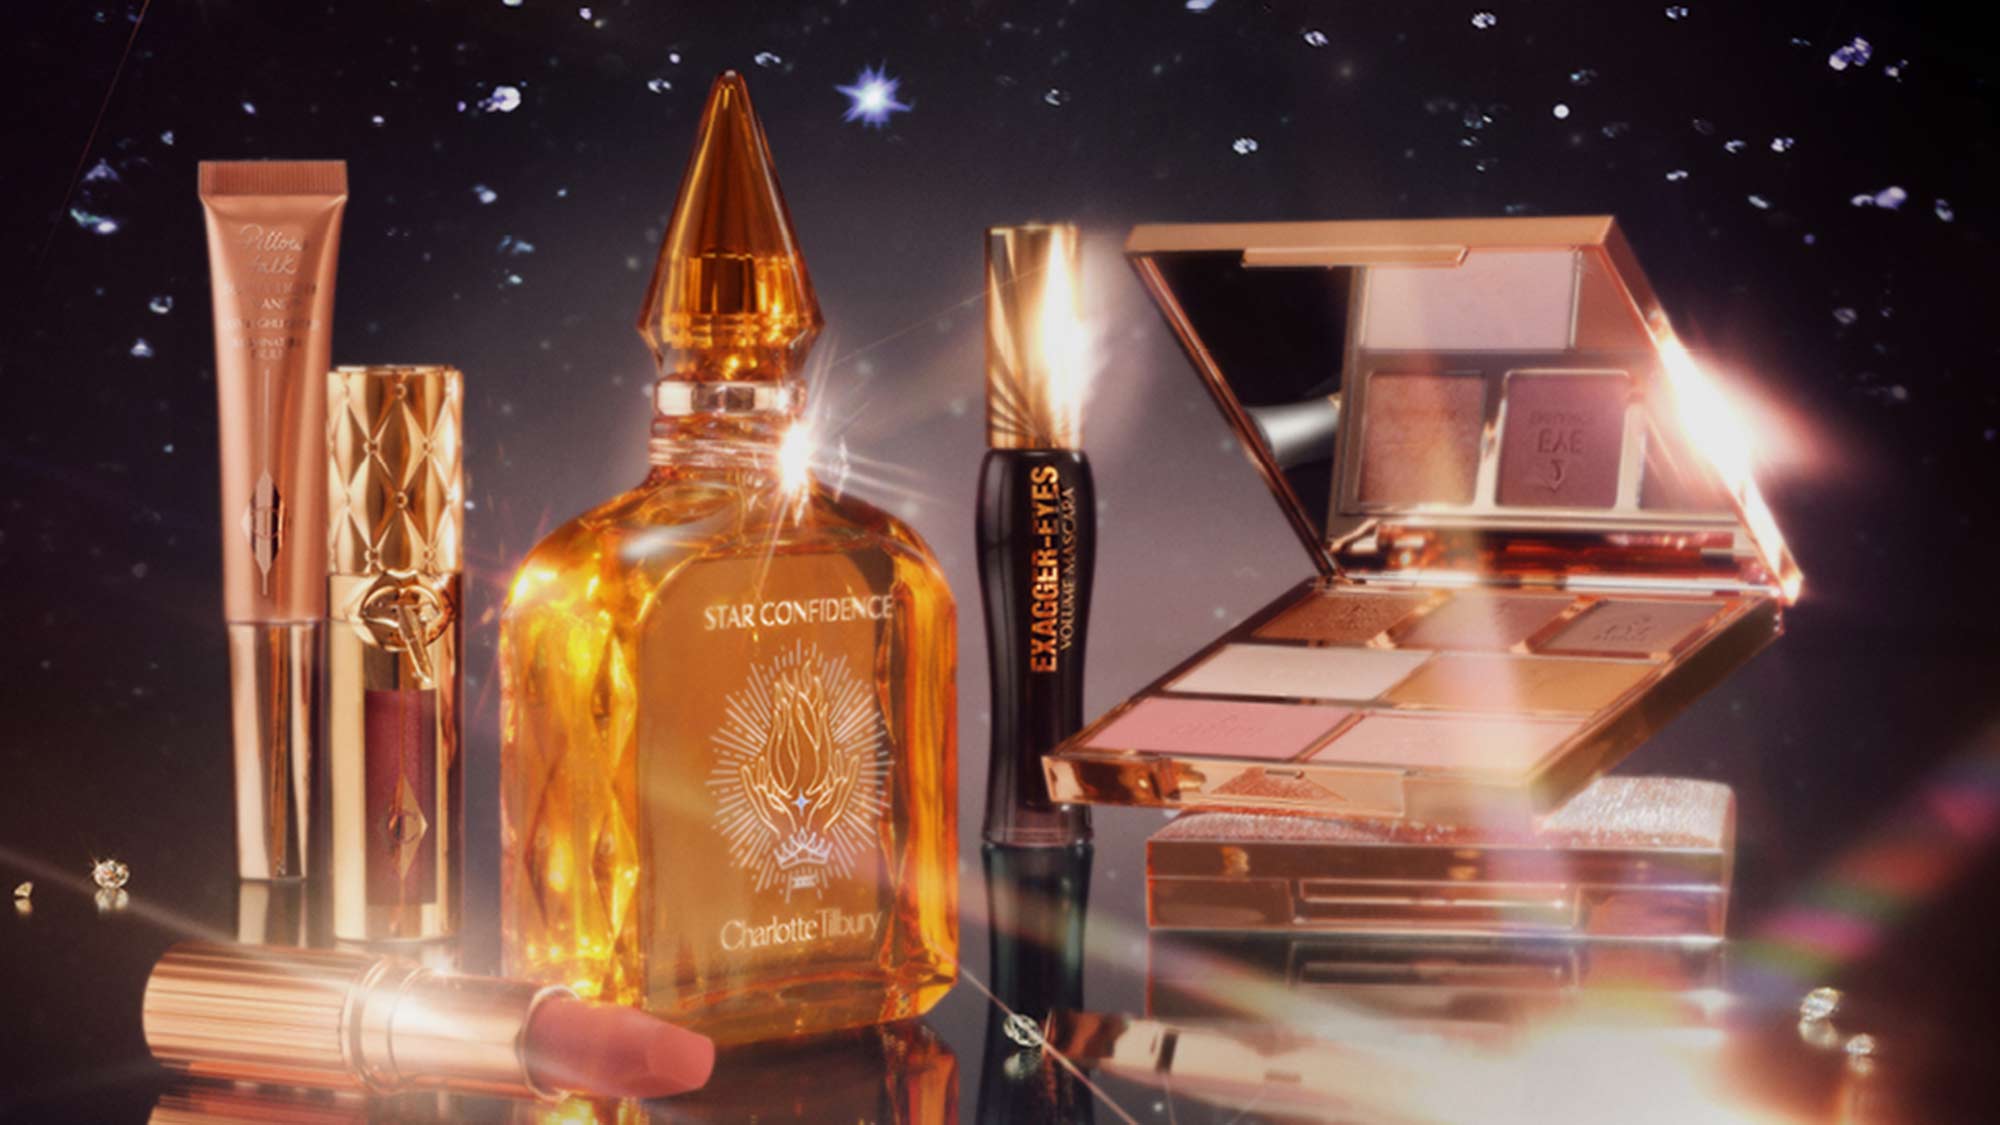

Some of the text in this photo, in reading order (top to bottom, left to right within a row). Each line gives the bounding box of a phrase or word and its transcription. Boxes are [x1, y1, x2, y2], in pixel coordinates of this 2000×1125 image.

[705, 595, 894, 631] STAR CONFIDENCE
[1030, 465, 1060, 672] EXAGGER-EYES
[1060, 487, 1077, 650] VOLUME MASCARA
[720, 909, 883, 952] Charlotte Tilbury
